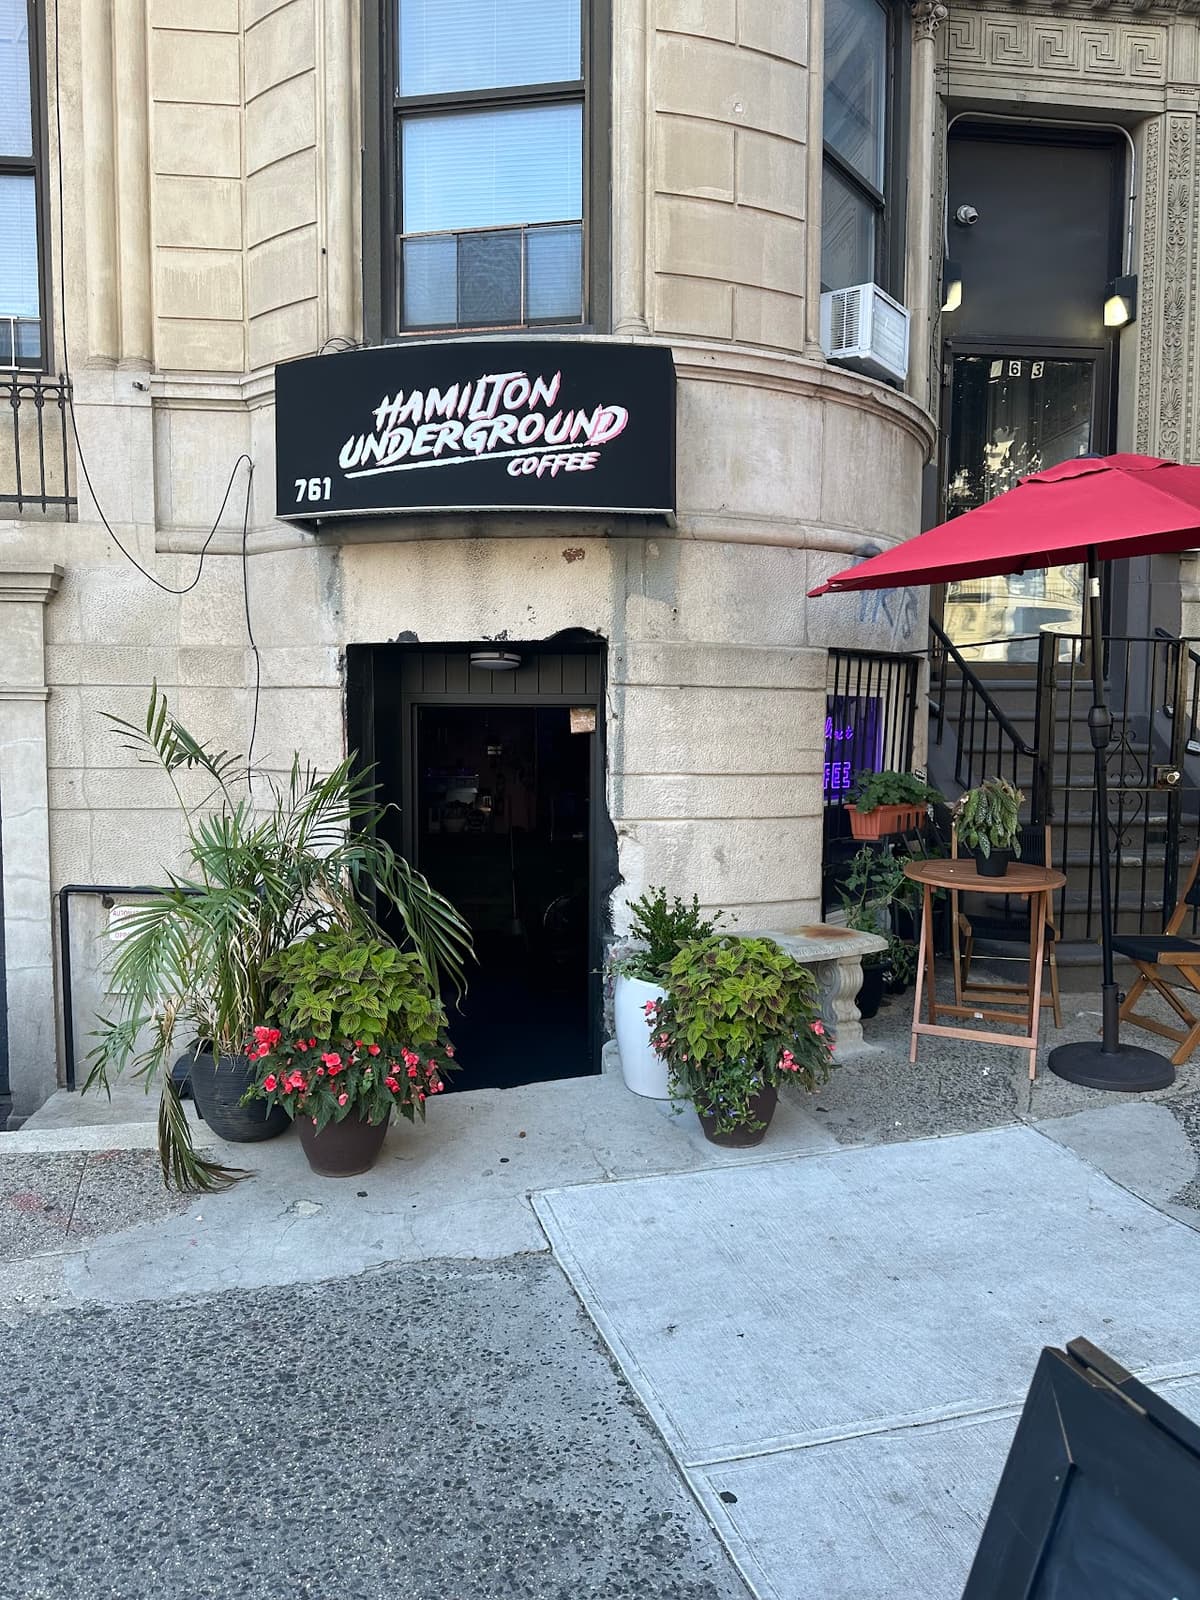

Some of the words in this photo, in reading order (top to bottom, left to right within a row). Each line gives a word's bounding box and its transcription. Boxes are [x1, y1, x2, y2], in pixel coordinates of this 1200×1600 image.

[371, 369, 562, 432] HAMILTON
[338, 403, 629, 470] UNDERGROUND
[506, 451, 601, 479] COFFEE
[294, 476, 332, 503] 761
